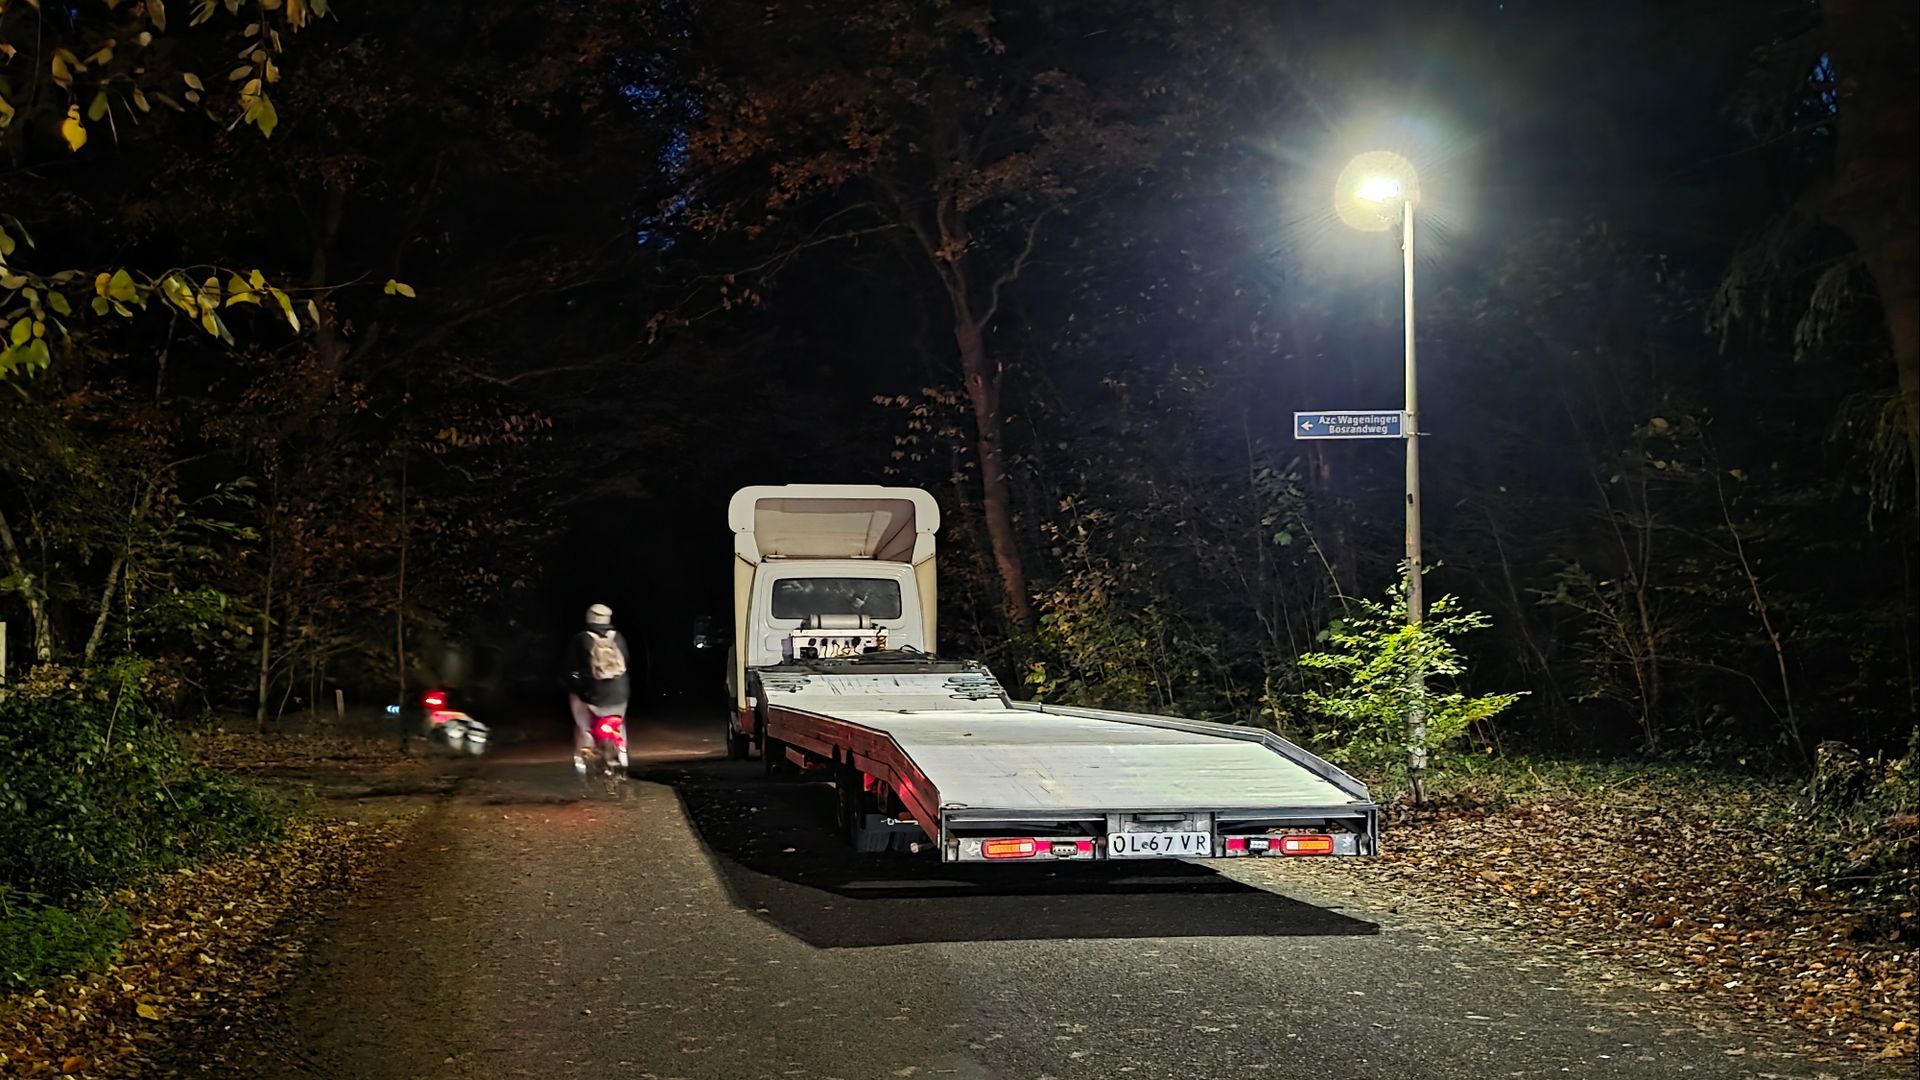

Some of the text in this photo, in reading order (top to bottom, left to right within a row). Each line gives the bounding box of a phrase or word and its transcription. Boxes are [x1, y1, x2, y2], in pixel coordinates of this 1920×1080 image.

[1318, 415, 1398, 426] Azc Wageningen
[1329, 425, 1388, 434] Bosrandweg
